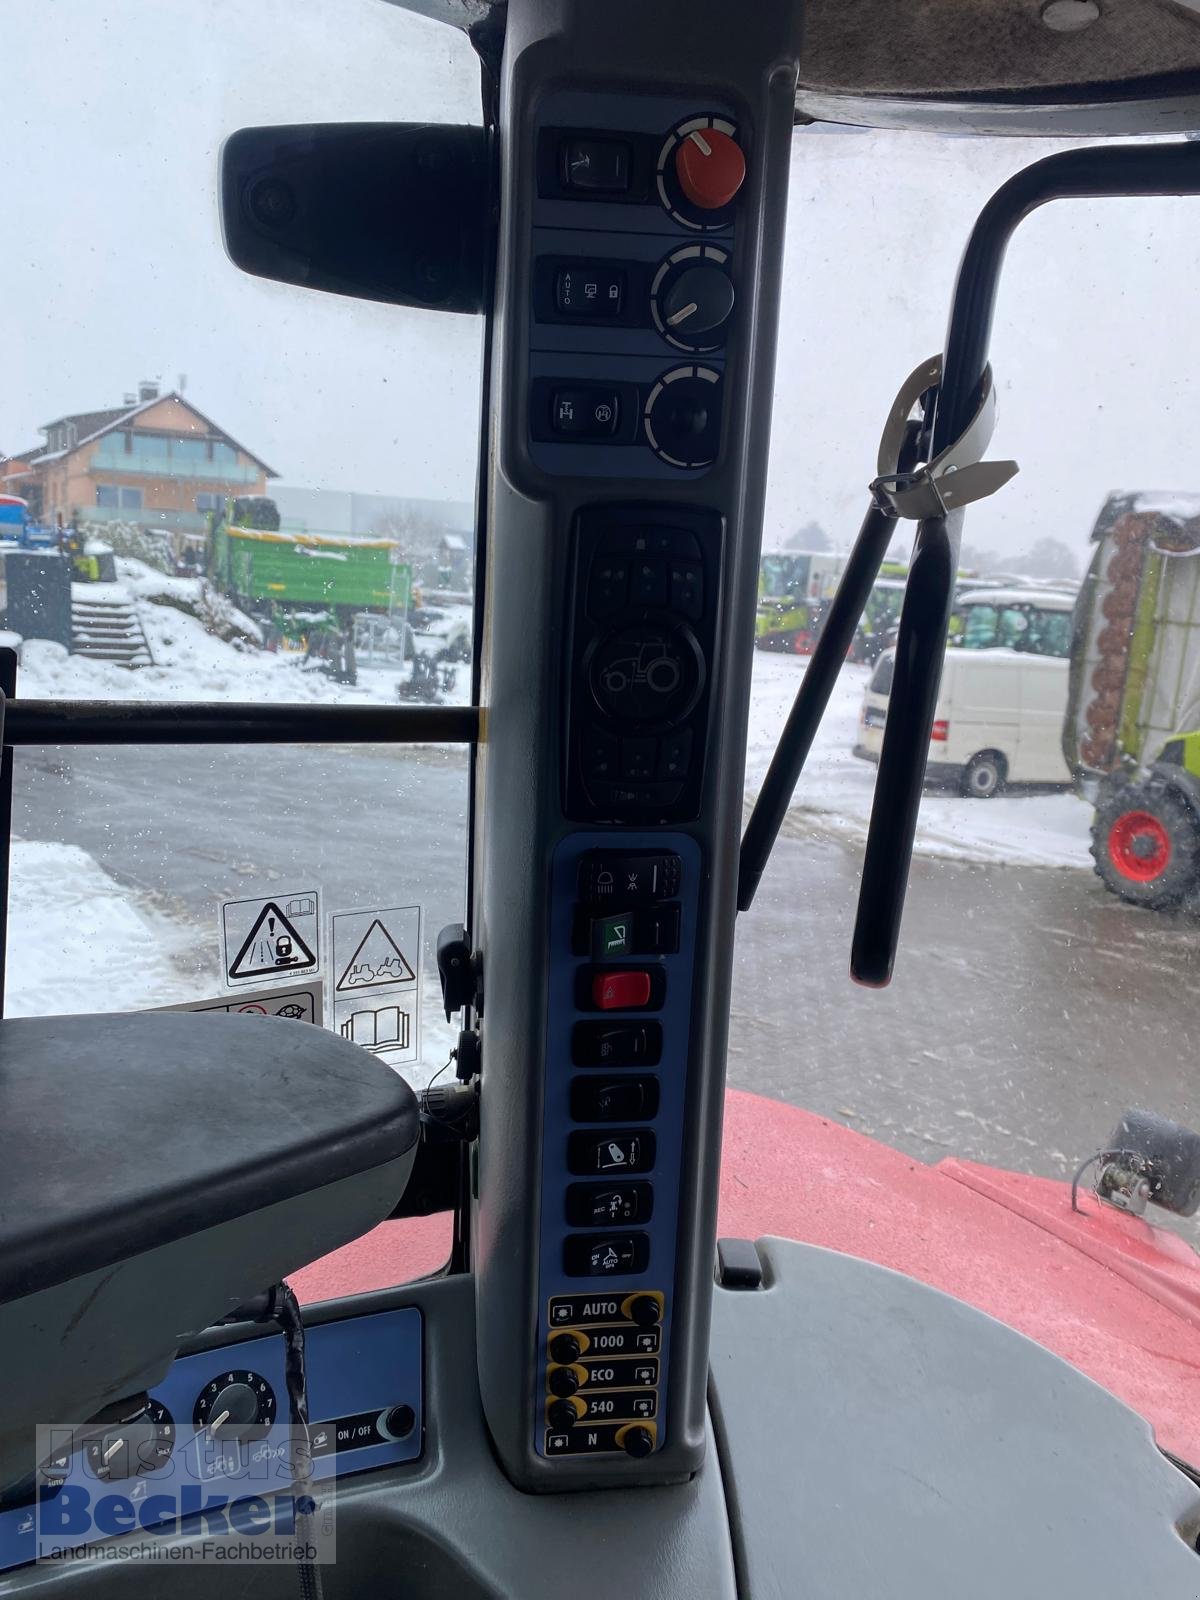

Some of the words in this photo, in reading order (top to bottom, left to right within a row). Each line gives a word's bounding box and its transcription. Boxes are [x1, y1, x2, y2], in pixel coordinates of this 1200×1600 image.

[582, 1302, 617, 1316] AUTO
[593, 1335, 624, 1348] 1000
[228, 1373, 234, 1382] 4
[247, 1373, 253, 1382] 5
[590, 1368, 615, 1381] ECO
[211, 1383, 217, 1392] 3
[260, 1383, 266, 1391] 6
[200, 1399, 206, 1408] 2
[267, 1398, 273, 1408] 7
[590, 1400, 614, 1413] 540
[157, 1409, 164, 1420] 7
[198, 1418, 203, 1427] 1
[264, 1417, 270, 1426] 8
[164, 1425, 170, 1435] 8
[337, 1429, 349, 1440] ON
[358, 1425, 371, 1436] OFF
[588, 1433, 598, 1445] N
[92, 1446, 98, 1456] 2
